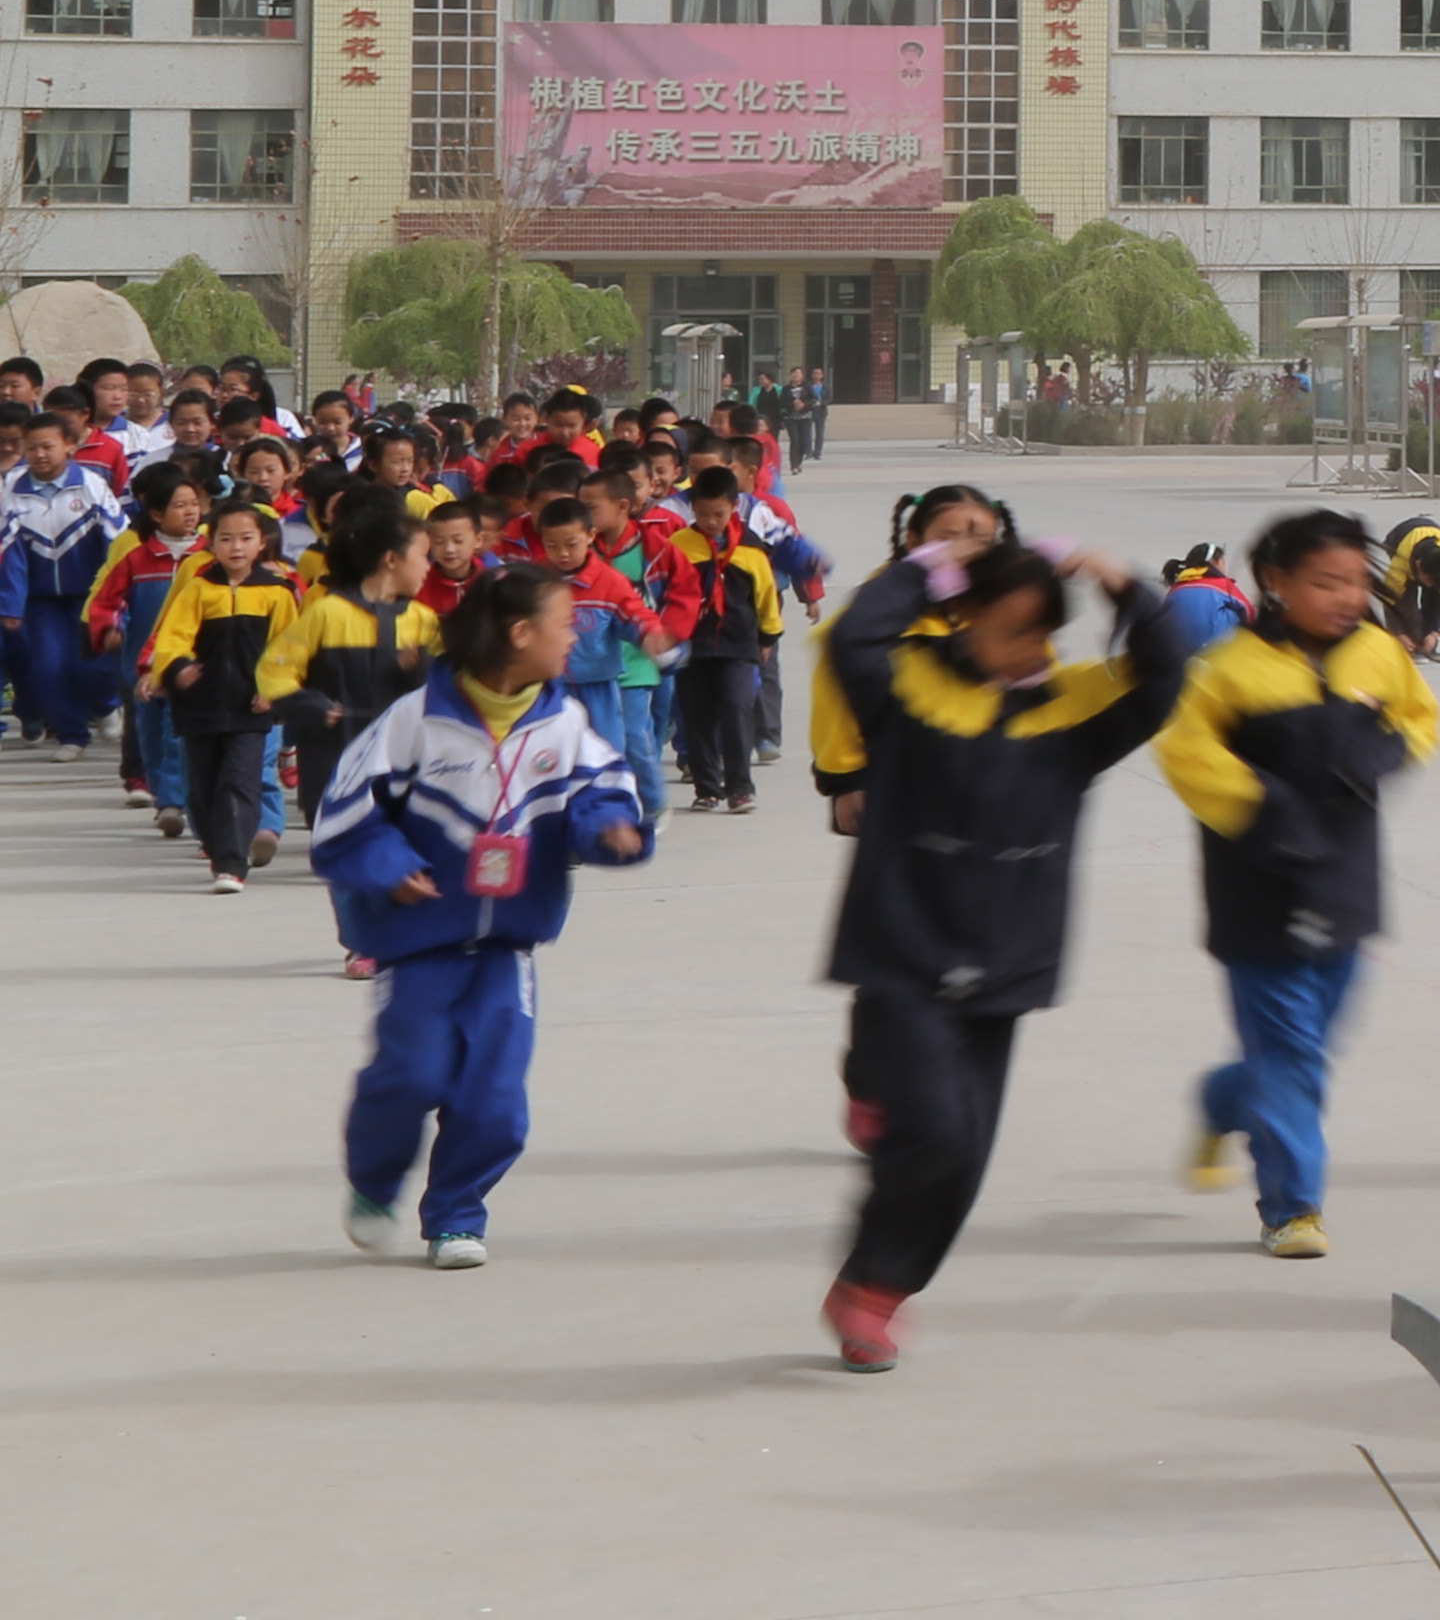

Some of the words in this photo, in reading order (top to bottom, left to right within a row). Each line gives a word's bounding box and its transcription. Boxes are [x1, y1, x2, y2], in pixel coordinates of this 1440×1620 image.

[529, 78, 847, 114] 根植红色文化沃土
[606, 130, 922, 164] 传承三五九旅精神
